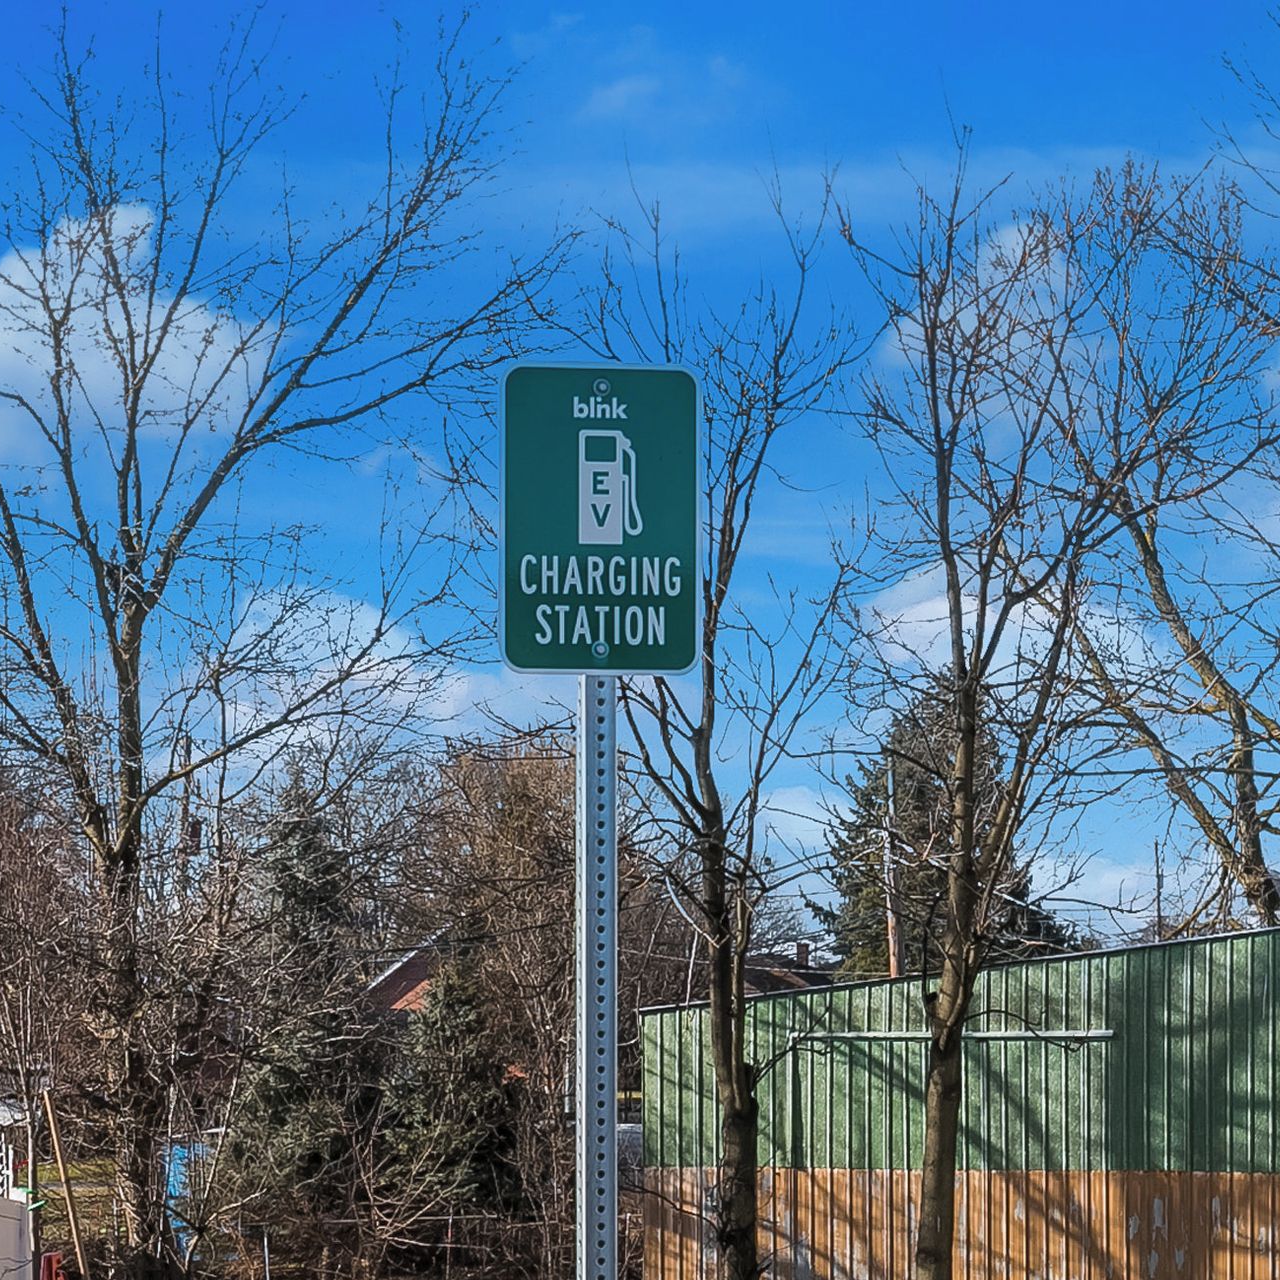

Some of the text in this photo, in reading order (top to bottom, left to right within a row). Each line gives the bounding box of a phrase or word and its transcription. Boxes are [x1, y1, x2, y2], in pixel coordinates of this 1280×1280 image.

[573, 396, 628, 419] blink
[520, 554, 681, 597] CHARGING
[535, 604, 665, 645] STATION
